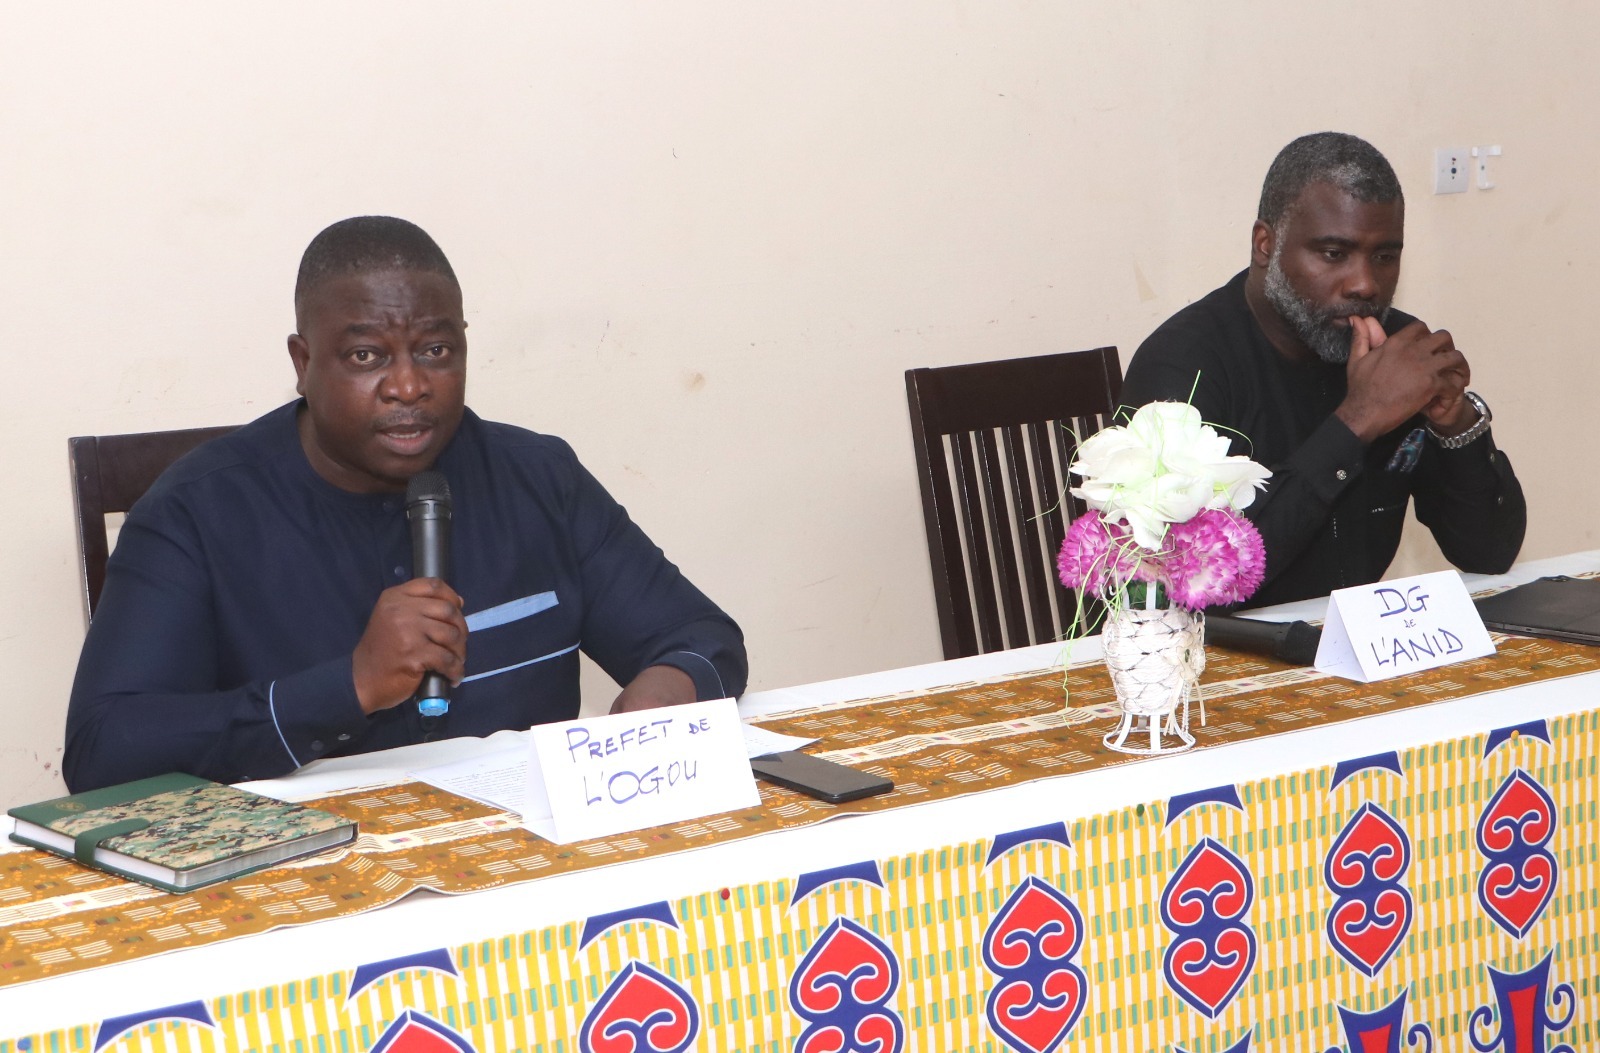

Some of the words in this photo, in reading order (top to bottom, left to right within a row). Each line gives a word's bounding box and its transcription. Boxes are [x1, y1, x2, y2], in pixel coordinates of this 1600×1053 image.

[1373, 585, 1430, 618] DG
[1370, 627, 1464, 667] L'ANID
[565, 718, 673, 763] PREFET
[688, 717, 711, 735] DE
[583, 759, 698, 806] L'OGOU
